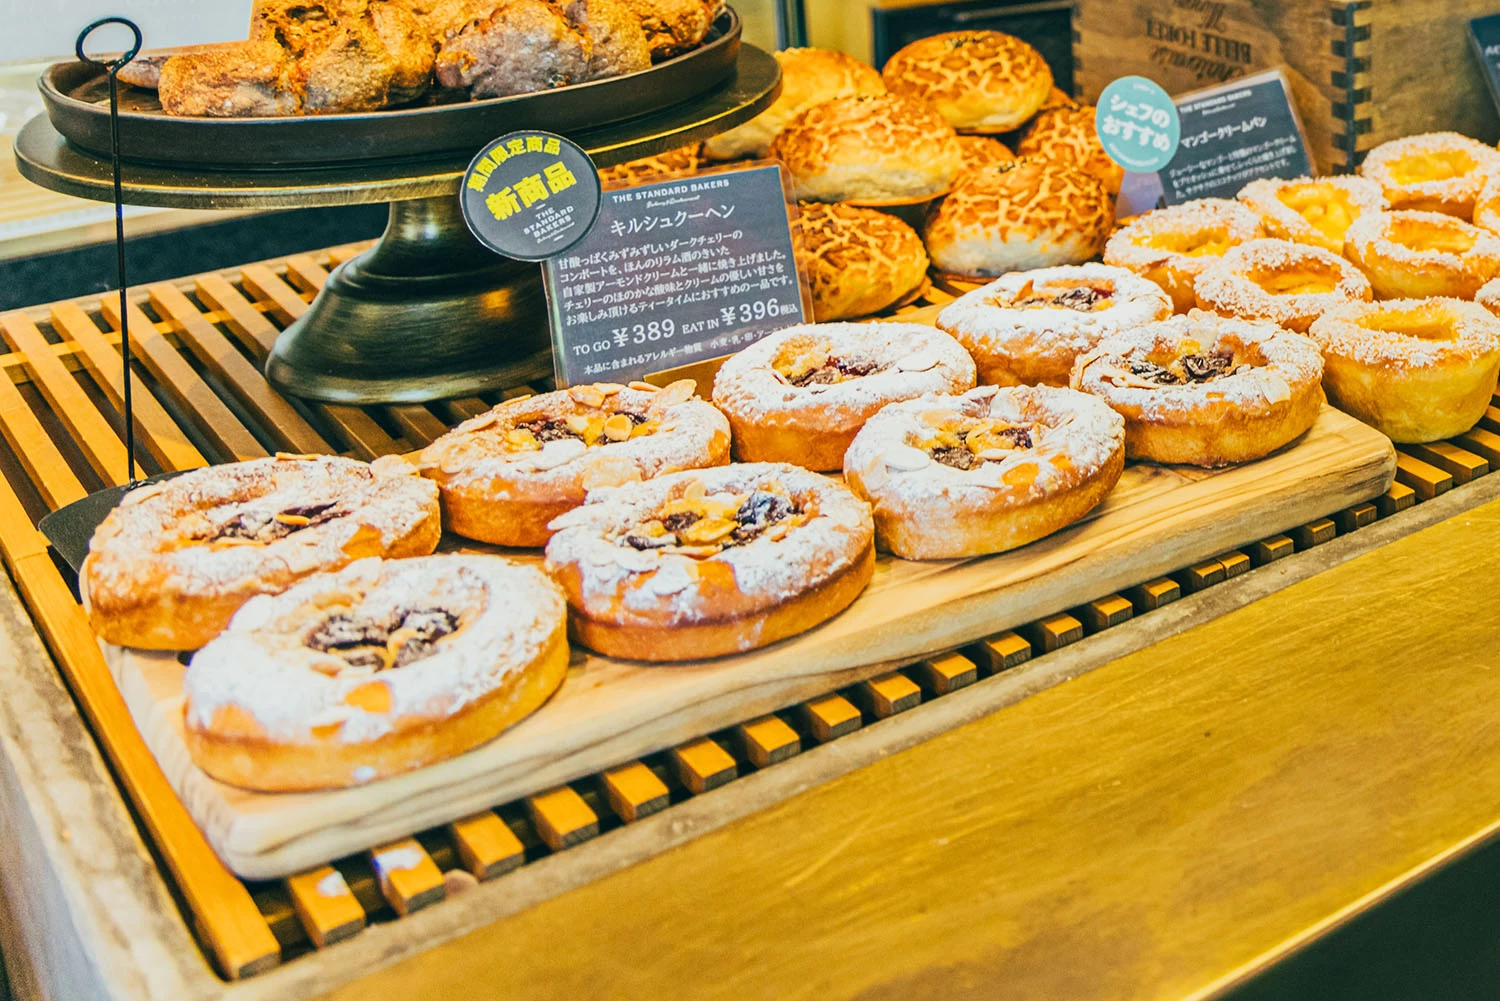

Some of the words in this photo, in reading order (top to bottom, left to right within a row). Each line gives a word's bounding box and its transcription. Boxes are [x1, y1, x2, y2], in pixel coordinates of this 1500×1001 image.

[1110, 93, 1171, 128] シェフの
[1102, 116, 1171, 152] おすすめ
[1180, 116, 1268, 149] マンゴークリームパン
[467, 136, 560, 191] 期間限定商品
[486, 160, 577, 221] 新商品
[612, 193, 633, 204] THE
[635, 184, 688, 200] STANDARD
[690, 179, 730, 192] BAKERS
[524, 205, 574, 235] STANDARD
[533, 215, 573, 238] BAKERS
[535, 207, 556, 220] THE
[610, 204, 735, 237] キルシュクーヘン
[573, 343, 591, 356] TO
[592, 339, 611, 353] GO
[612, 318, 675, 348] ¥389
[682, 320, 705, 335] EAT
[706, 318, 719, 330] IN
[720, 297, 780, 326] ¥396
